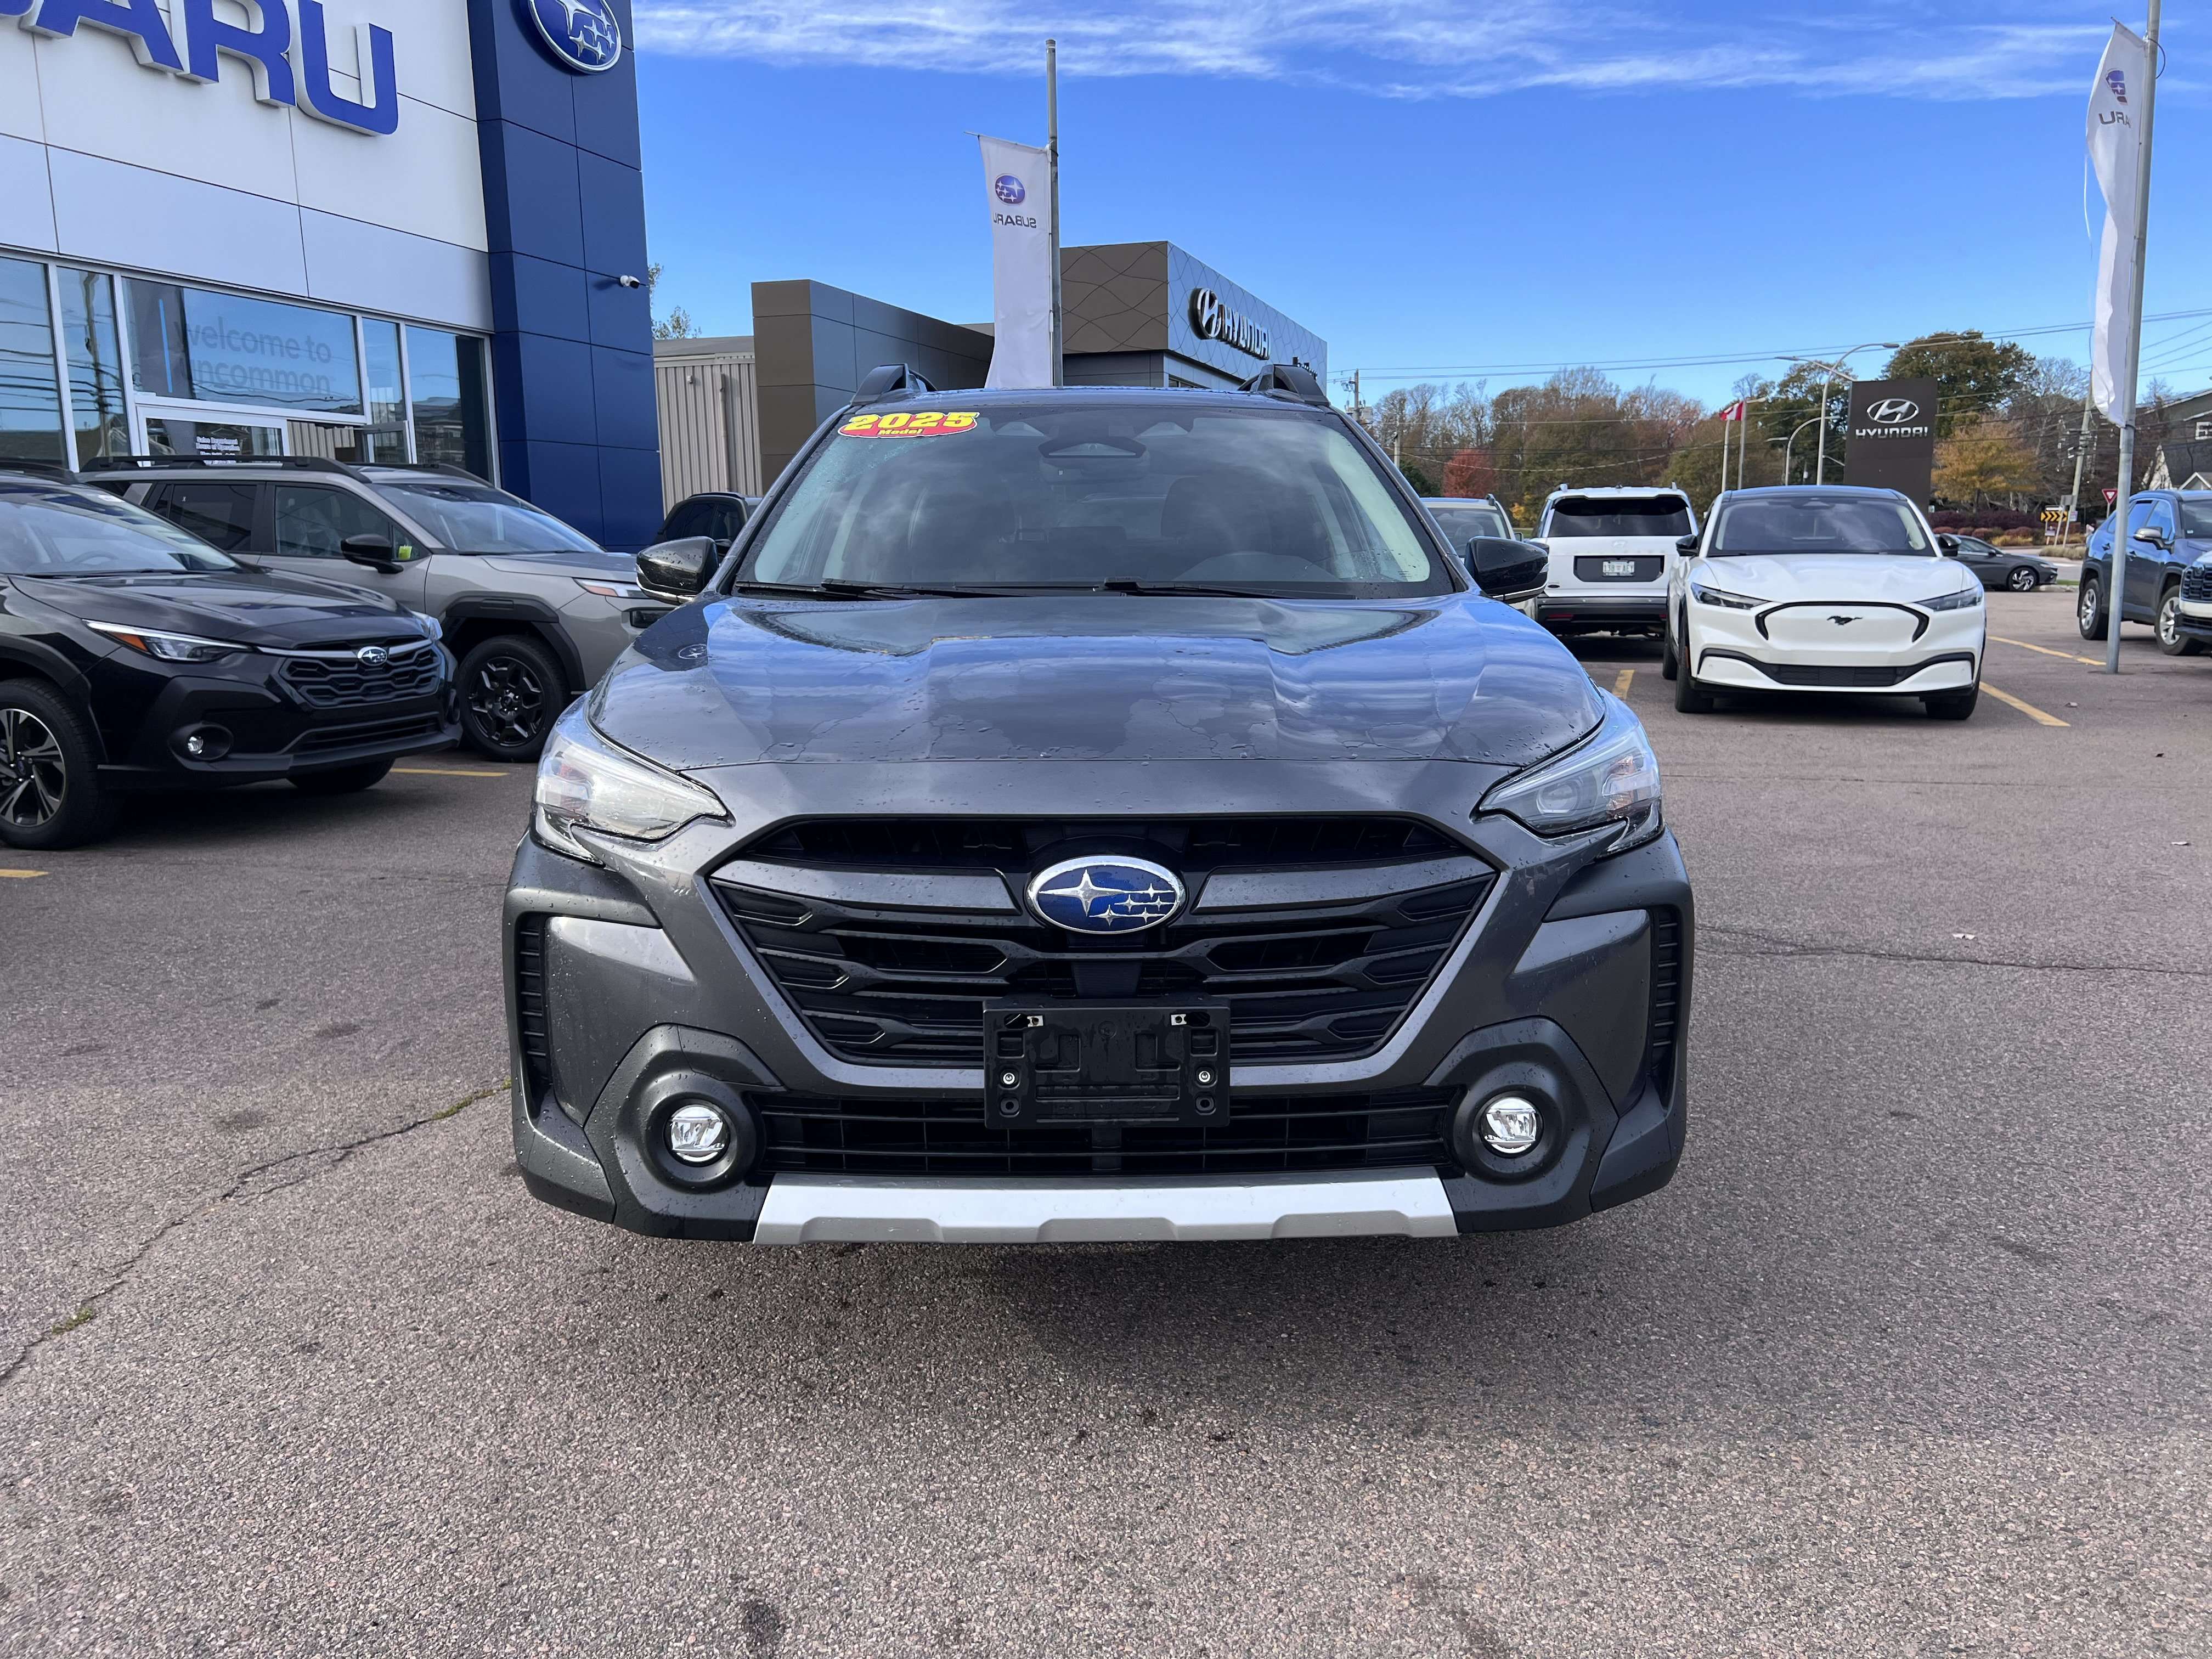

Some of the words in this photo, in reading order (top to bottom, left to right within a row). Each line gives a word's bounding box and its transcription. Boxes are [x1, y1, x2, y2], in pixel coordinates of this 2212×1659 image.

[0, 0, 398, 136] ARU
[173, 315, 300, 359] welcome
[306, 335, 332, 363] to
[1222, 305, 1271, 360] HYUNDAI
[179, 358, 330, 392] uncommon
[844, 412, 979, 431] 2025
[1855, 427, 1928, 439] HYUNDAI
